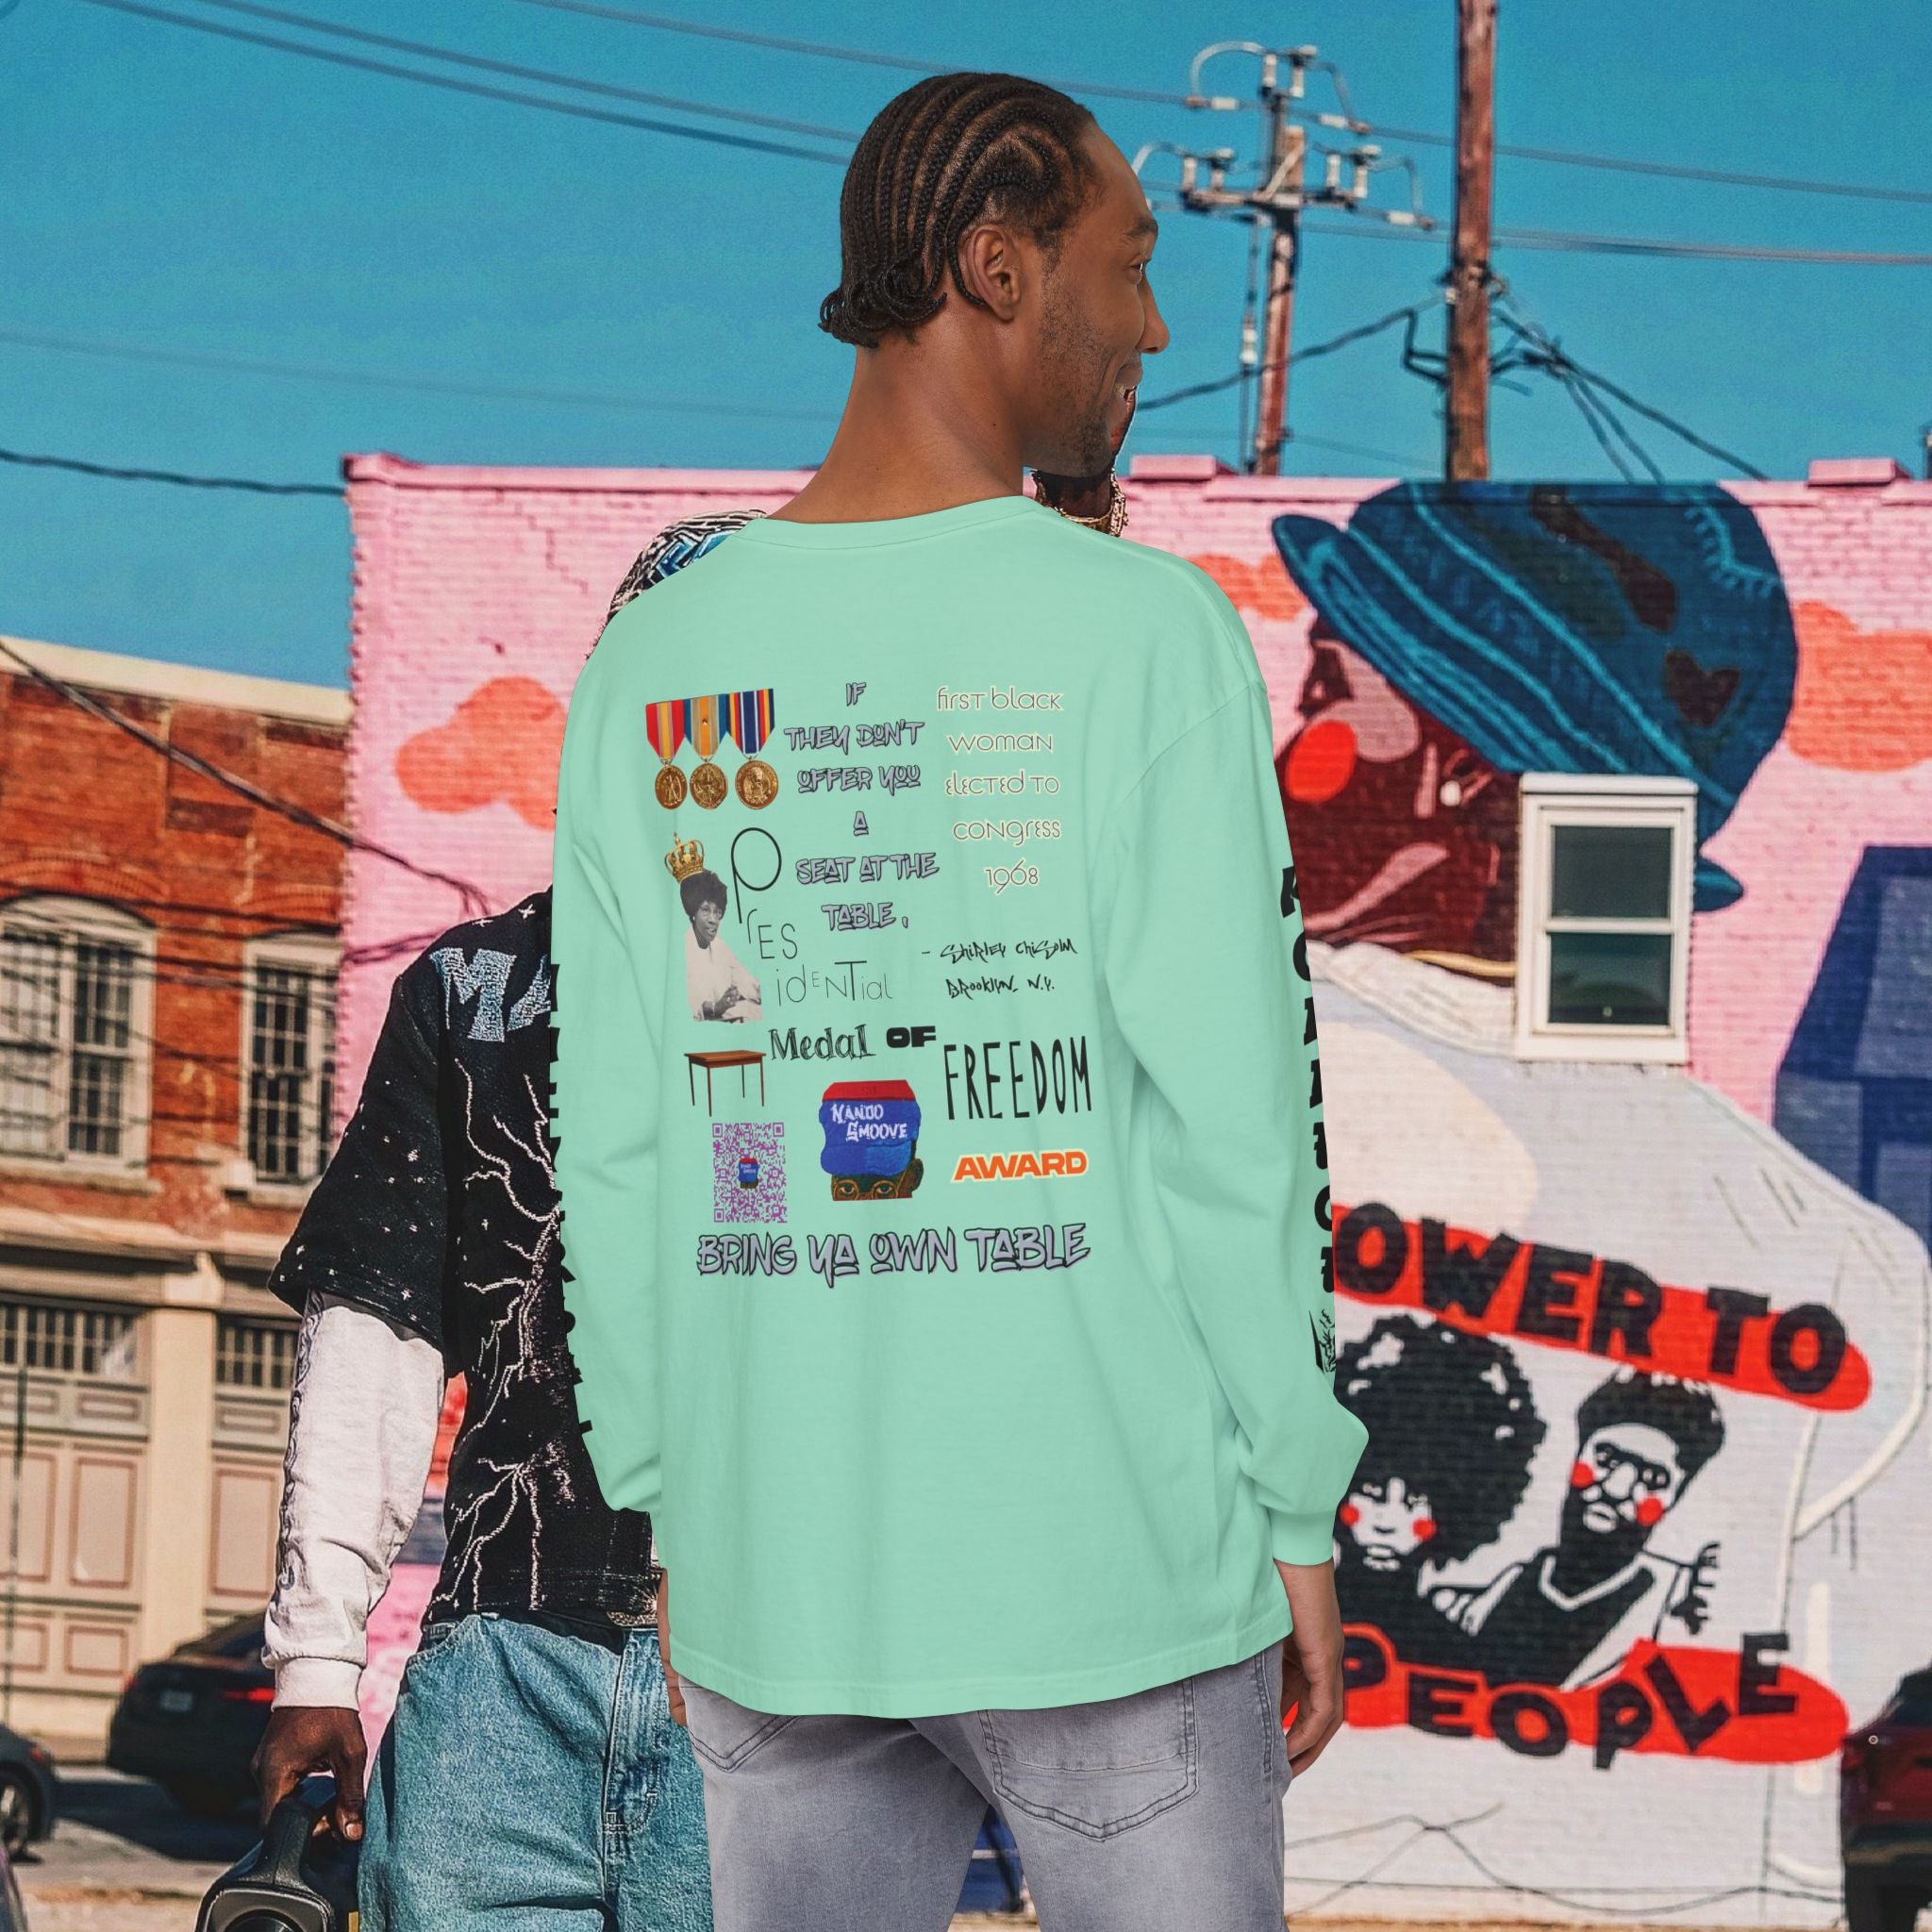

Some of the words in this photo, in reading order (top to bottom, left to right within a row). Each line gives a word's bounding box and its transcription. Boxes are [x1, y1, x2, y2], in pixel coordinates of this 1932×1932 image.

[845, 682, 867, 707] IF
[991, 686, 1064, 710] black
[783, 725, 851, 756] THEY
[856, 719, 925, 748] DON'T
[797, 767, 873, 794] OFFER
[878, 764, 922, 796] YOU
[853, 810, 870, 837] A
[795, 857, 856, 885] SEAT
[859, 855, 889, 883] AT
[889, 852, 941, 880] THE
[984, 858, 1040, 894] 1968
[767, 1024, 876, 1061] Medal
[886, 1025, 937, 1049] OF
[943, 1036, 1092, 1121] FREEDOM
[951, 1149, 1089, 1182] AWARD
[696, 1231, 797, 1277] BRING
[807, 1234, 860, 1289] YA
[869, 1225, 958, 1275] OWN
[963, 1223, 1091, 1274] TABLE
[1706, 1286, 1847, 1395] TO
